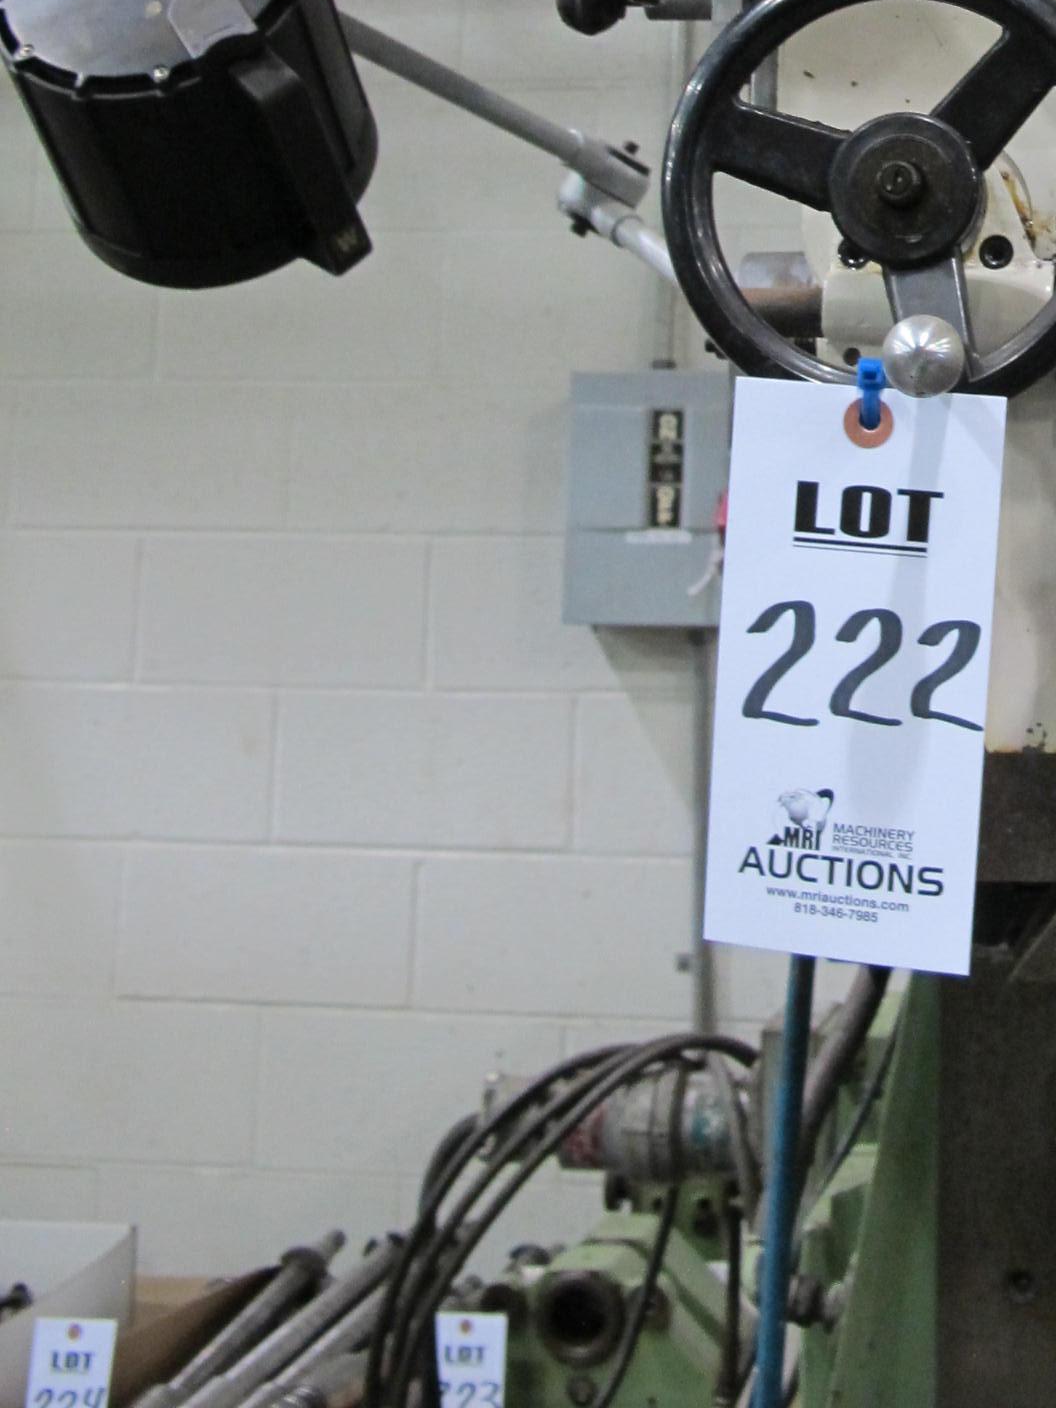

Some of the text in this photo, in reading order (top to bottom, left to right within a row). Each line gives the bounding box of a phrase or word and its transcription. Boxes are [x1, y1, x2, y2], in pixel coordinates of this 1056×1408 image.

[795, 480, 945, 543] LOT
[742, 600, 985, 732] 222
[783, 826, 821, 851] MRI
[832, 834, 914, 853] RESOURCES
[833, 822, 915, 842] MACHINERY
[738, 846, 944, 897] AUCTIONS
[766, 885, 910, 913] www.mriauctions.com
[794, 902, 878, 924] 818-346-7985
[52, 1350, 94, 1369] LOT
[444, 1345, 484, 1364] LOT
